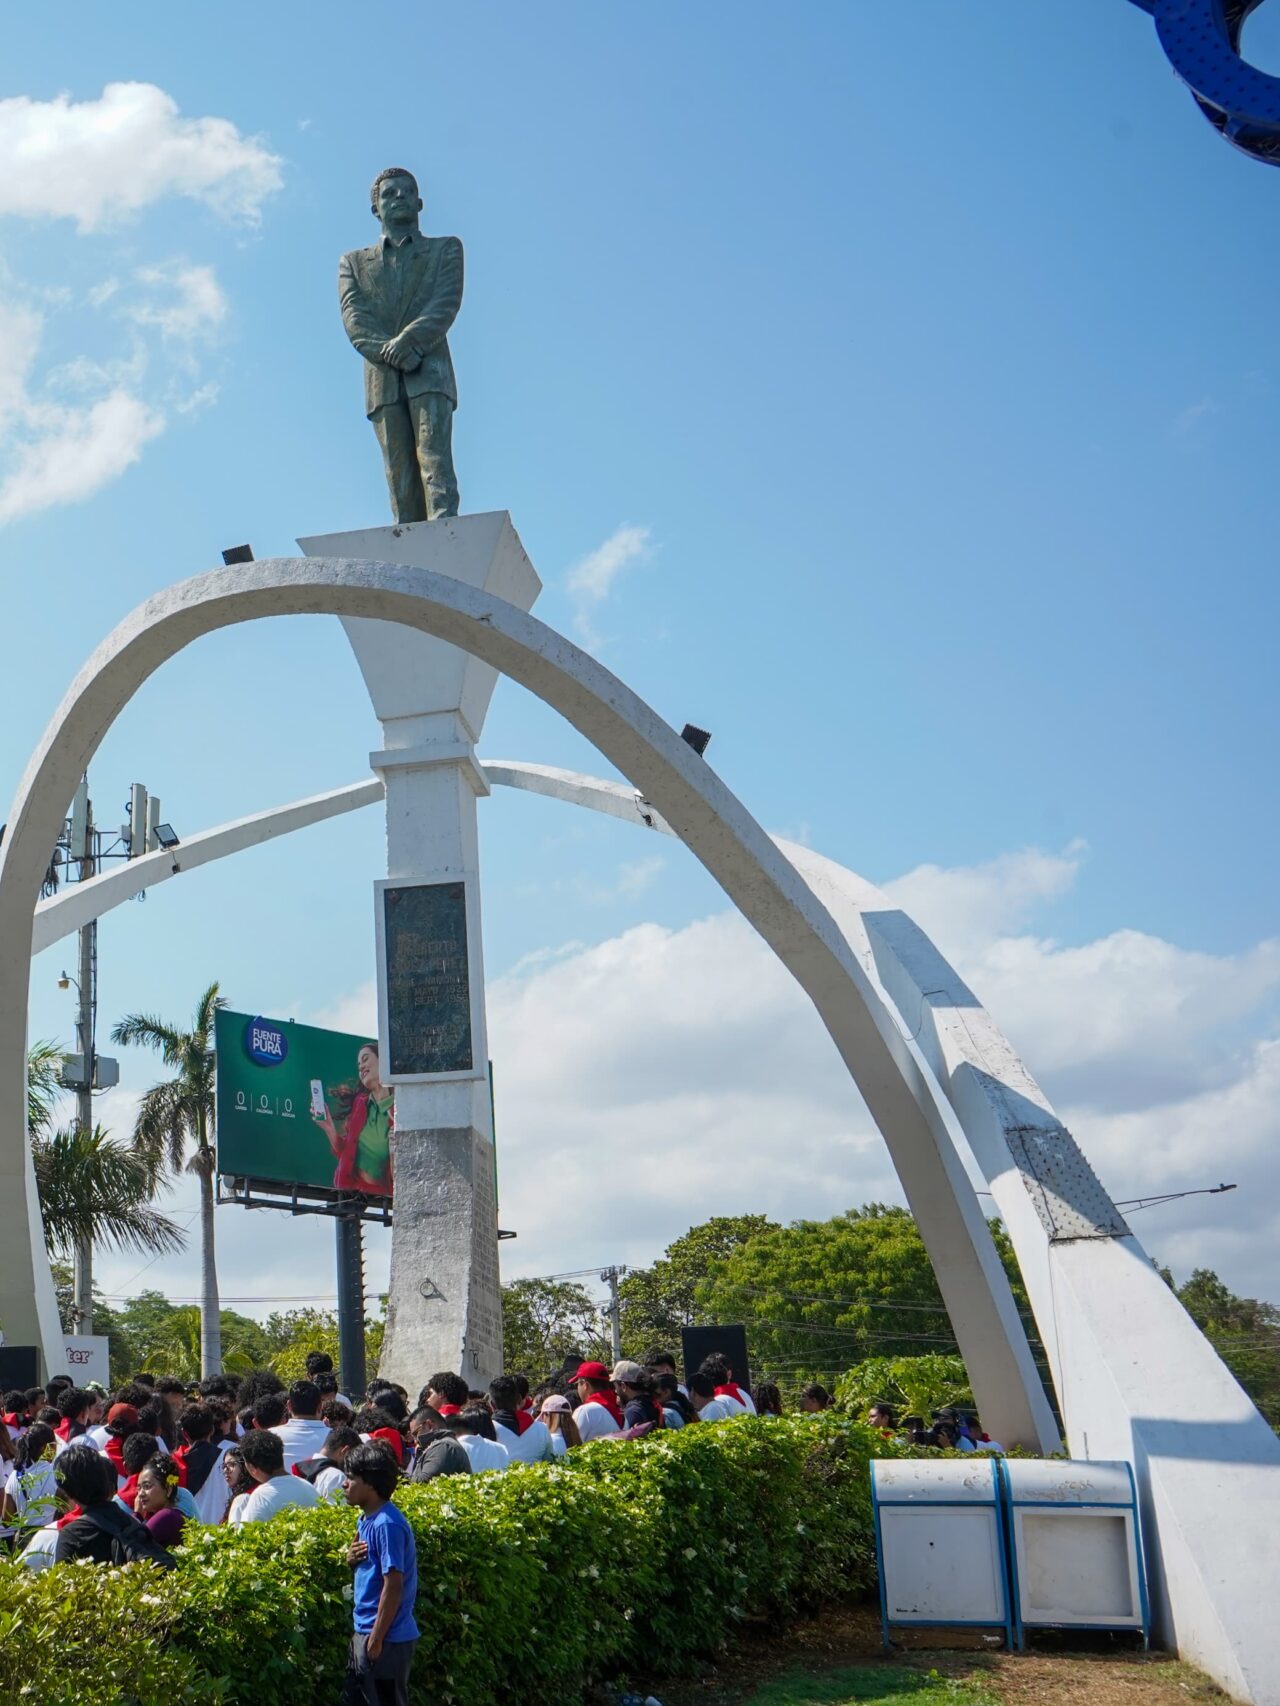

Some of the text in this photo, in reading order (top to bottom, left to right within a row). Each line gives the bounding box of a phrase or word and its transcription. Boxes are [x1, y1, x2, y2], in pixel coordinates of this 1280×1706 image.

[253, 1028, 281, 1043] FUENTE
[253, 1038, 282, 1056] PURA
[237, 1091, 292, 1112] 0 0 0
